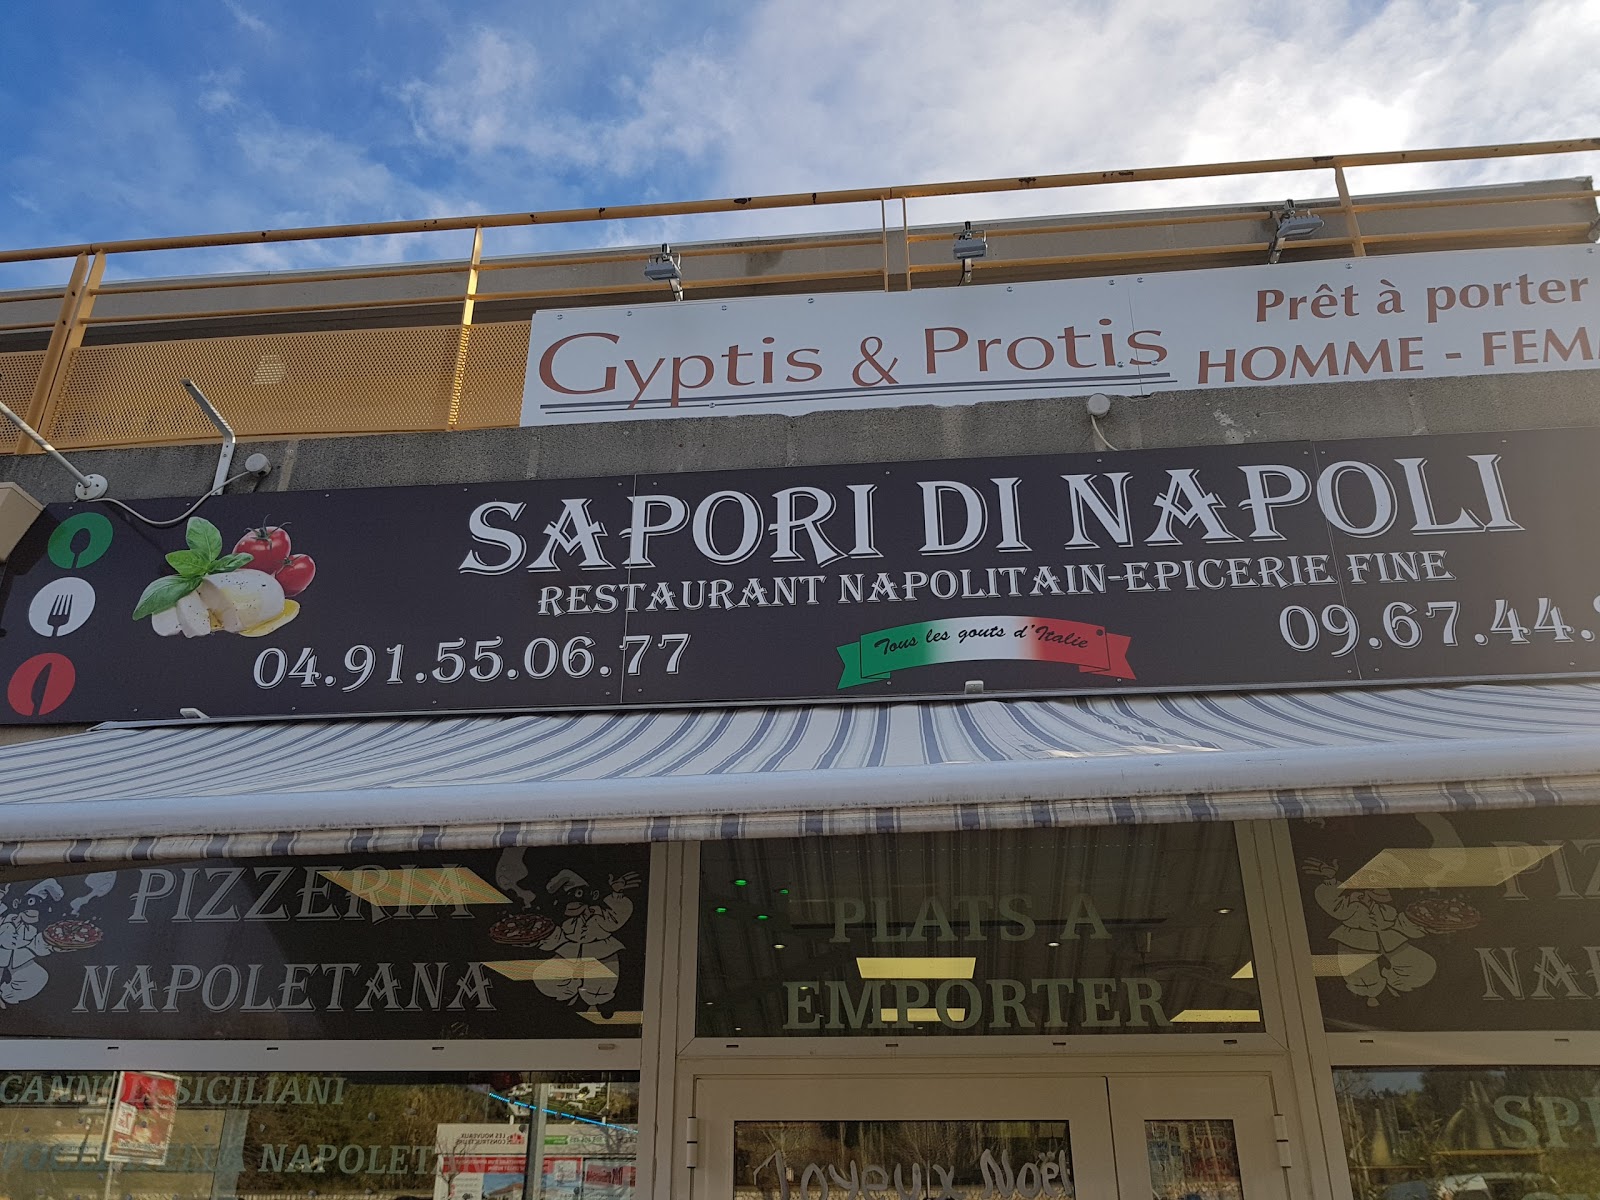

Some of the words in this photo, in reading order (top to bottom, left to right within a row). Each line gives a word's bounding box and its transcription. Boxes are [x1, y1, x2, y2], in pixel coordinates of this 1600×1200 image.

[1256, 283, 1360, 323] Prêt
[1376, 279, 1405, 315] à
[1427, 273, 1589, 323] porter
[538, 331, 823, 409] Gyptis
[851, 335, 900, 387] &
[923, 318, 1169, 375] Protis
[1197, 336, 1424, 384] HOMME
[1482, 326, 1600, 367] FEM
[457, 483, 885, 576] SAPORI
[915, 476, 1033, 557] DI
[1060, 453, 1527, 550] NAPOLI
[537, 574, 828, 617] RESTAURANT
[837, 553, 1337, 605] NAPOLITAIN-EPICERIE
[1347, 549, 1457, 585] FINE
[873, 637, 919, 656] Tous
[925, 628, 951, 644] les
[958, 625, 1007, 644] gouts
[1013, 624, 1090, 650] d'Italie
[1278, 592, 1600, 659] 09.67.44.
[252, 631, 693, 693] 04.91.55.06.77
[127, 863, 477, 926] PIZZERIA
[828, 894, 1038, 945] PLATS
[1058, 892, 1113, 941] A
[71, 960, 498, 1014] NAPOLETANA
[781, 976, 1174, 1032] EMPORTER
[178, 1075, 348, 1105] SICILIANI
